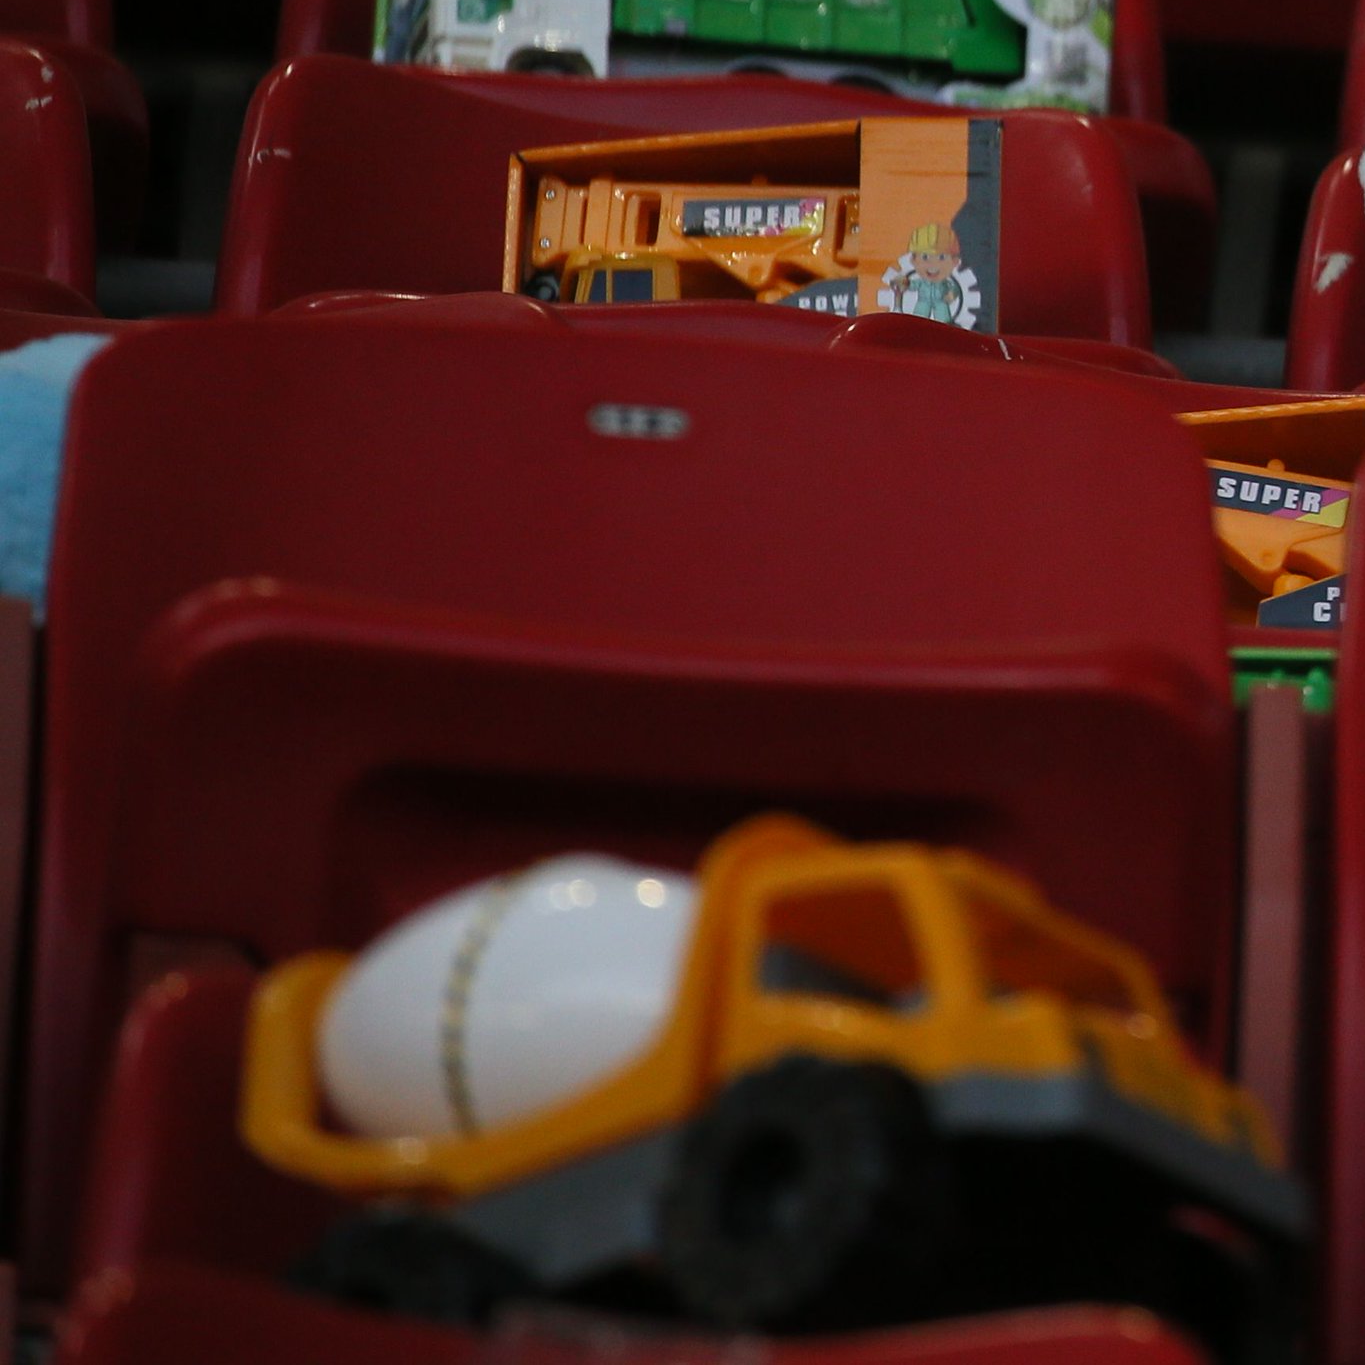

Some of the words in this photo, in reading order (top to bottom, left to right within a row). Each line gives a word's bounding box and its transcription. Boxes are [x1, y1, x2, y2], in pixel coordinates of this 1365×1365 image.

[702, 204, 801, 231] SUPER
[798, 292, 858, 311] POW
[1216, 476, 1322, 513] SUPER
